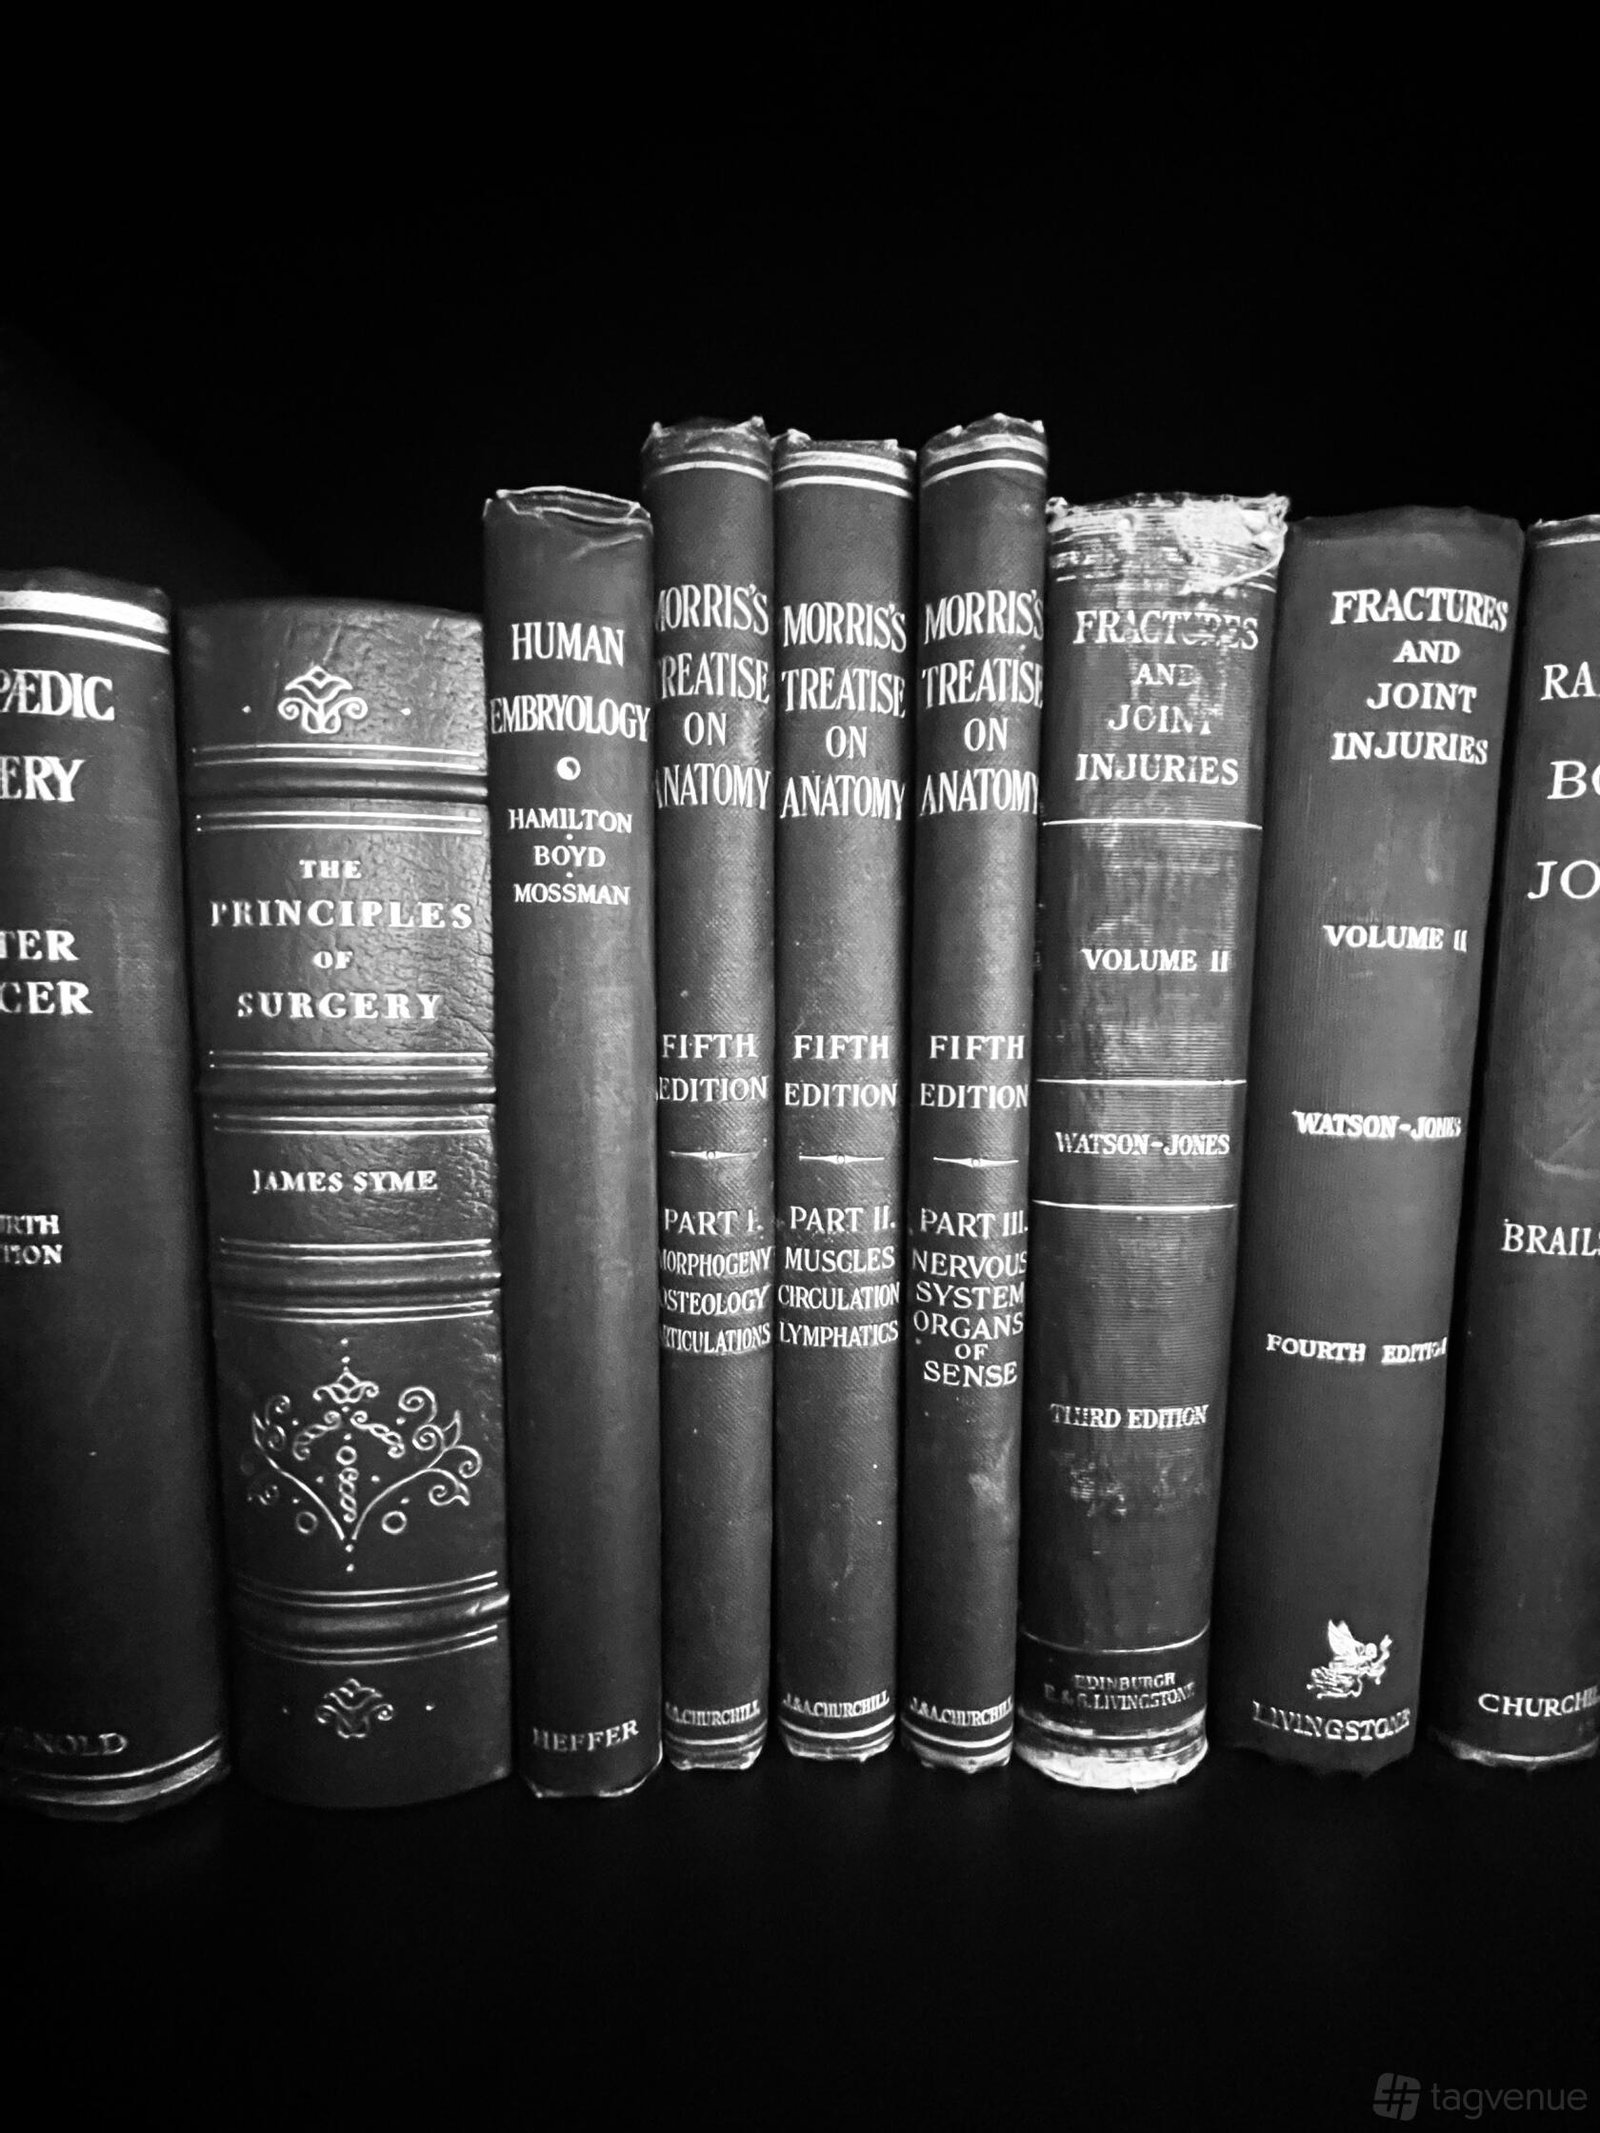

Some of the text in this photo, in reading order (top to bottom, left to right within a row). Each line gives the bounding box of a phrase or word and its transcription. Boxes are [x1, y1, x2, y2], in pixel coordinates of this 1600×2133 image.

[924, 589, 1043, 645] MORRIS'S
[1330, 586, 1509, 632] FRACTURES
[783, 602, 907, 653] MORRIS'S
[1073, 610, 1260, 650] FRACTURES
[511, 621, 625, 667] HUMAN
[1393, 640, 1461, 664] AND
[658, 651, 770, 704] REATISE
[922, 657, 1043, 710] TREATISE
[1131, 663, 1200, 687] AND
[1540, 661, 1600, 701] RA
[781, 667, 906, 718] TREATISE
[1366, 681, 1477, 714] JOINT
[490, 693, 650, 742] EMBRYOLOGY
[683, 711, 727, 746] ON
[825, 725, 868, 759] ON
[963, 717, 1008, 752] ON
[1330, 731, 1489, 766] INJURIES
[1075, 753, 1240, 786] INJURIES
[779, 774, 906, 820] ANATOMY
[508, 808, 632, 833] HAMILTON
[299, 859, 361, 879] THE
[533, 845, 606, 867] BOYD
[513, 883, 630, 905] MOSSMAN
[210, 899, 473, 928] PRINCIPLES
[1322, 924, 1444, 952] VOLUME
[313, 950, 353, 970] OF
[1081, 948, 1232, 972] VOLUME II
[236, 992, 440, 1020] SURGERY
[662, 1033, 758, 1059] FIFTH
[793, 1035, 889, 1059] FIFTH
[929, 1035, 1025, 1060] FIFTH
[658, 1075, 769, 1102] EDITION
[784, 1082, 898, 1107] EDITION
[920, 1082, 1028, 1109] EDITION
[1055, 1132, 1231, 1156] WATSON-JONES
[251, 1168, 438, 1194] JAMES SYME
[664, 1208, 738, 1235] PART
[790, 1205, 864, 1233] PART
[920, 1207, 996, 1239] PART
[1500, 1218, 1600, 1257] BRAIL
[785, 1245, 896, 1273] MUSCLES
[912, 1249, 1027, 1280] NERVOUS
[777, 1281, 900, 1311] CIRCULATION
[916, 1281, 1025, 1310] SYSTEM
[779, 1320, 899, 1348] LYMPHATICS
[913, 1310, 1024, 1340] ORGANS
[955, 1342, 989, 1360] OF
[1265, 1333, 1367, 1363] FOURTH
[923, 1361, 1018, 1388] SENSE
[1049, 1402, 1210, 1430] THIRD EDITION
[532, 1719, 639, 1752] HEFFER
[1252, 1700, 1412, 1742] LIVINGSTONE
